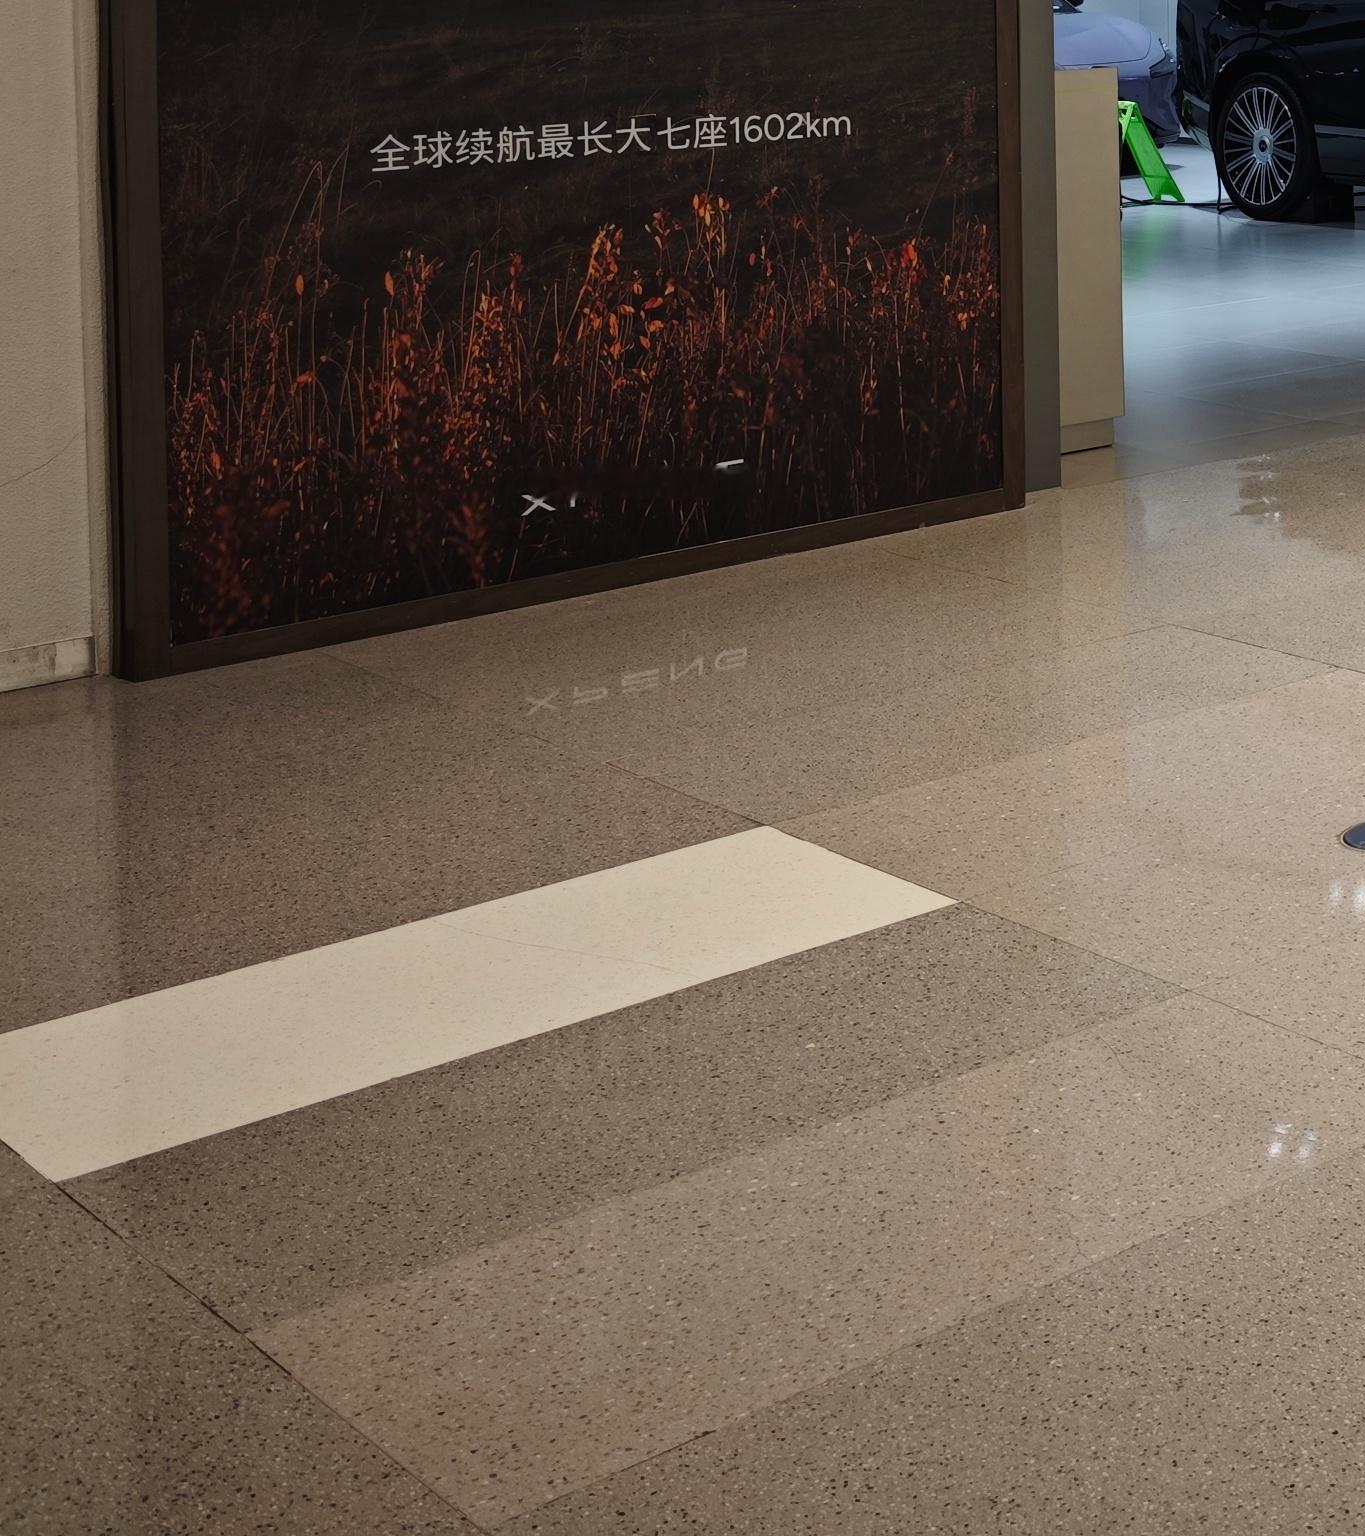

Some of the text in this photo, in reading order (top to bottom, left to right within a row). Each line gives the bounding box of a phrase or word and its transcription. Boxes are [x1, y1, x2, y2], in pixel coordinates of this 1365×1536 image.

[369, 112, 852, 173] 全球续航最长大七座1602km
